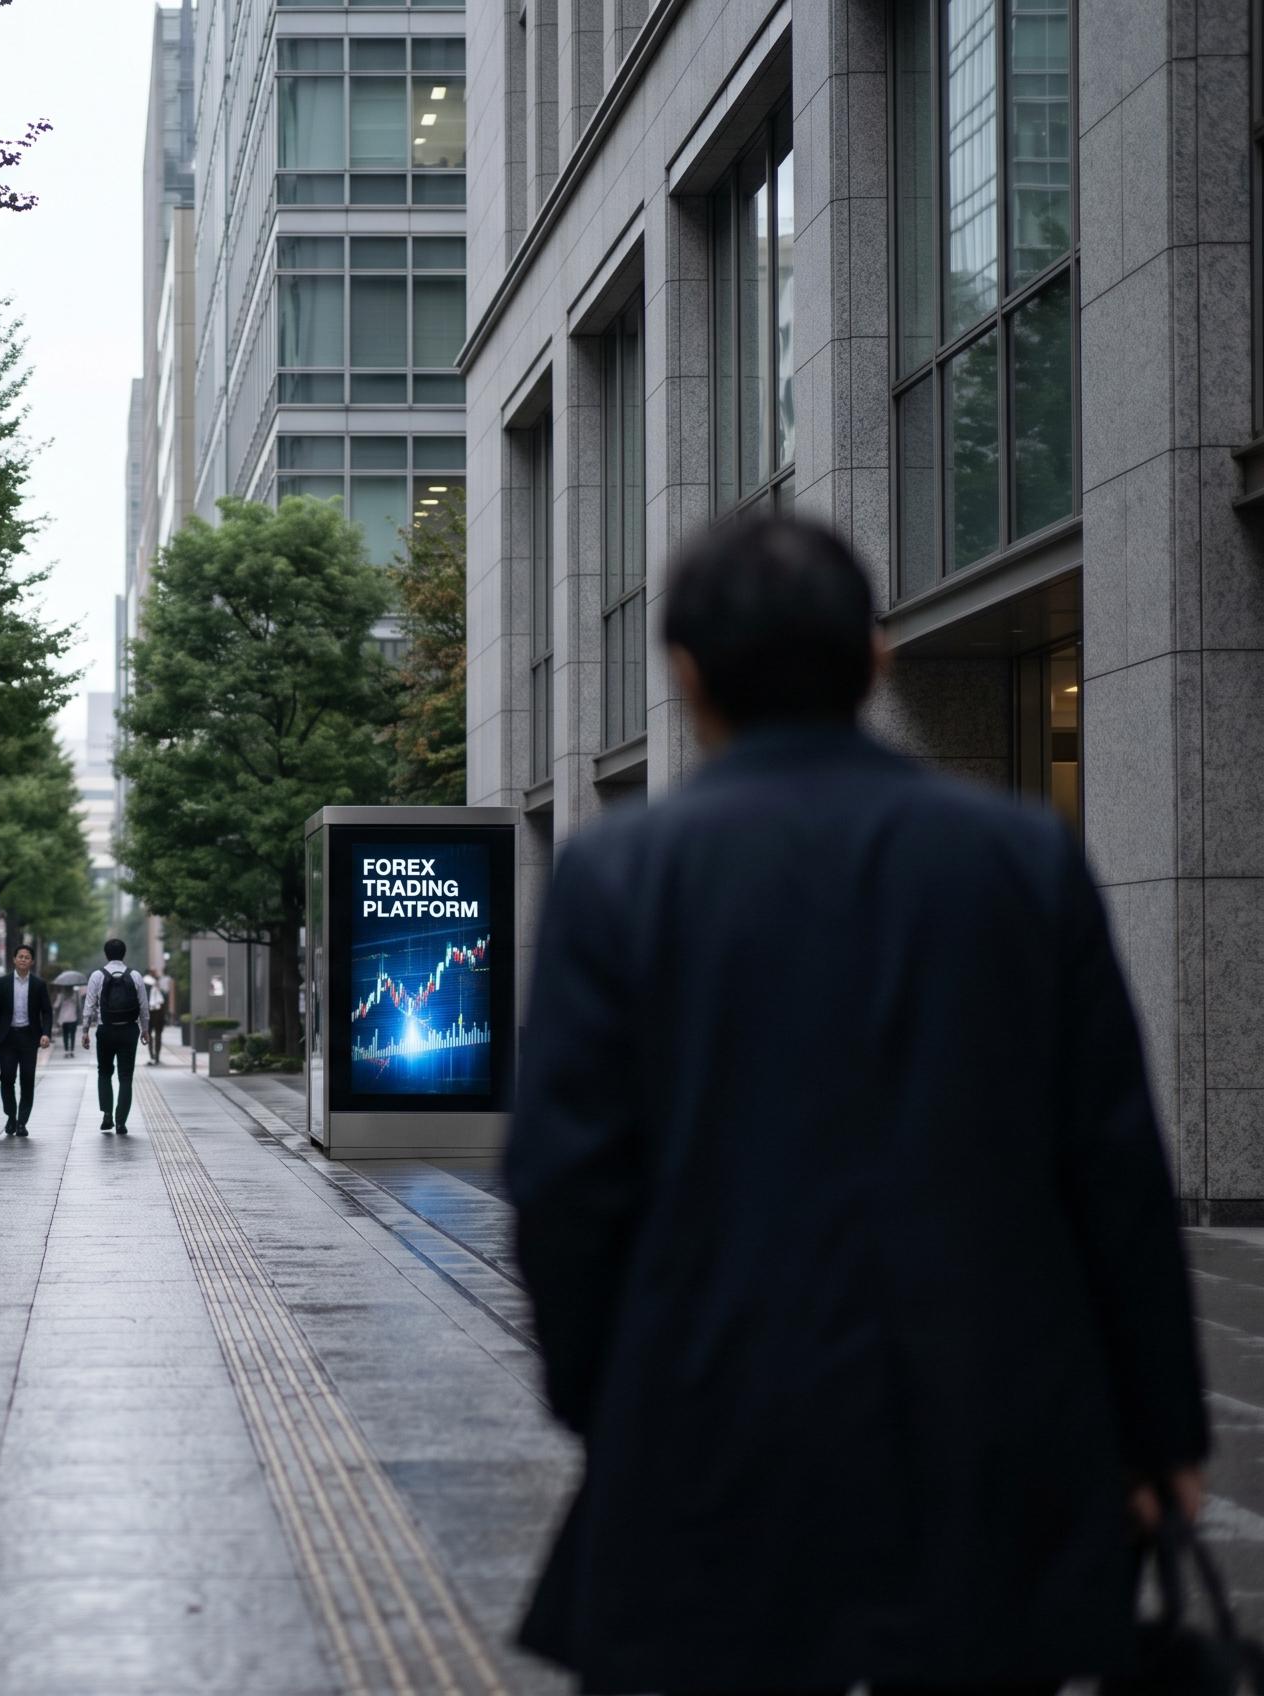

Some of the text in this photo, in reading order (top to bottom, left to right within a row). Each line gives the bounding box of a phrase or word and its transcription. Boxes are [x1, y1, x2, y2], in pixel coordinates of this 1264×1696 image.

[362, 858, 436, 876] FOREX
[362, 879, 459, 897] TRADING
[362, 900, 479, 918] PLATFORM
